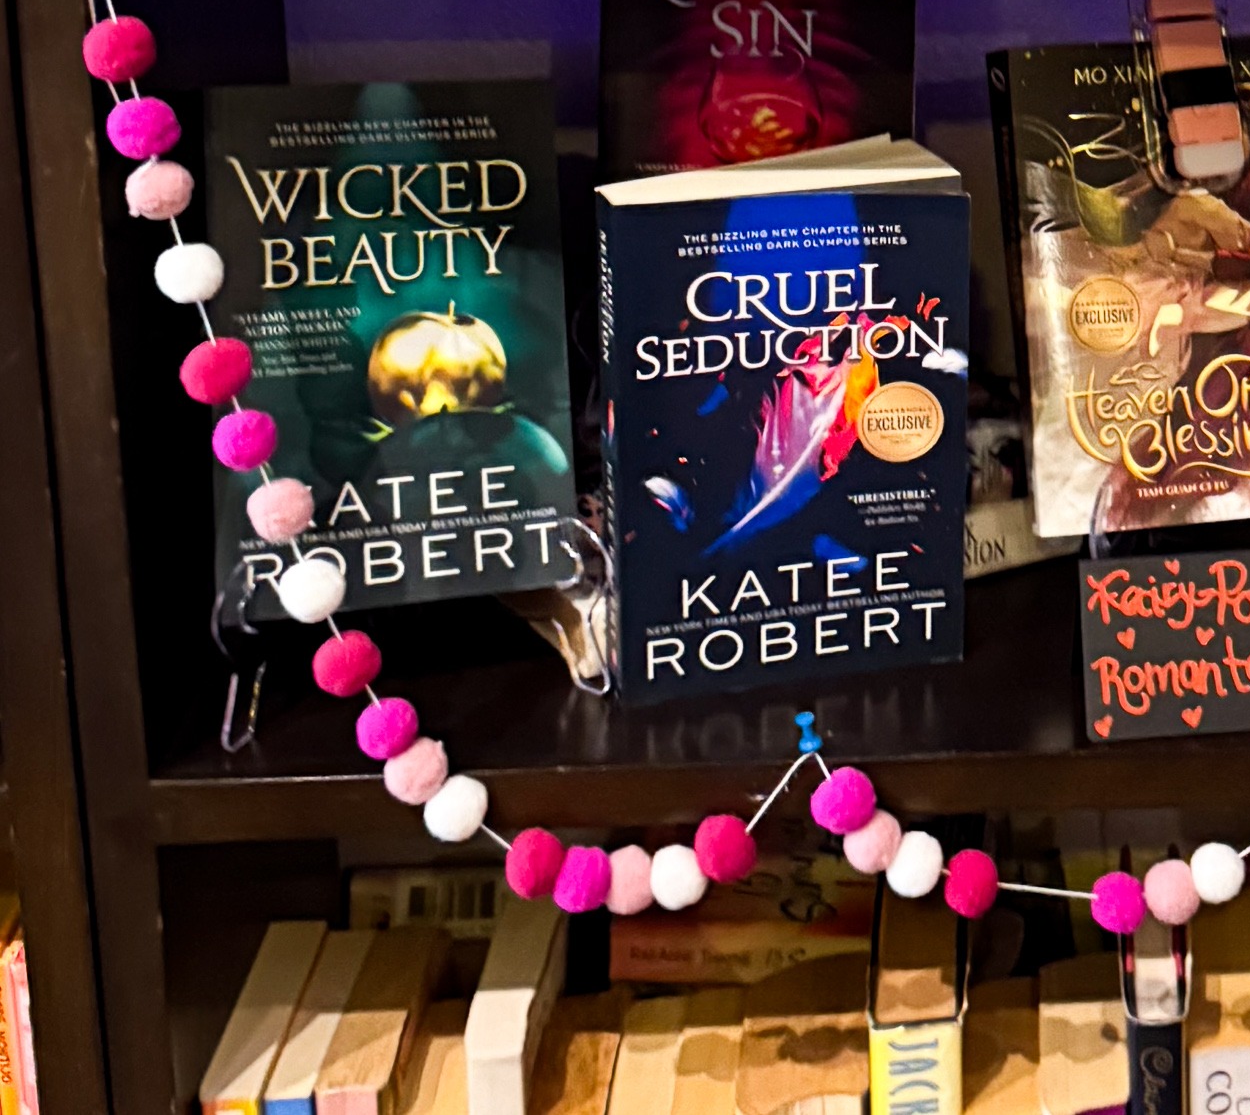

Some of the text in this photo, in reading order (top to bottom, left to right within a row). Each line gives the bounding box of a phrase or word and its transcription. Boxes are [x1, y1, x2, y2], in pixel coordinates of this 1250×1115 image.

[710, 0, 819, 59] SIN
[1073, 66, 1108, 86] MO
[224, 155, 528, 228] WICKED
[261, 224, 516, 296] BEAUTY
[677, 235, 909, 258] BESTSELLING DARK OLYMPUS SERIES
[683, 223, 902, 245] THE SIZZLING NEW CHAPTER IN THE
[686, 263, 897, 330] CRUEL
[1074, 308, 1135, 327] EXCLUSIVE
[635, 316, 949, 381] SEDUCTION
[866, 414, 934, 433] EXCLUSIVE
[1065, 367, 1198, 464] Heaven
[308, 465, 520, 528] ATEE
[431, 513, 509, 531] BESTSELLING
[510, 506, 557, 523] AUTHOR
[680, 551, 910, 619] KATEE
[901, 587, 946, 603] AUTHOR
[645, 601, 947, 682] ROBERT
